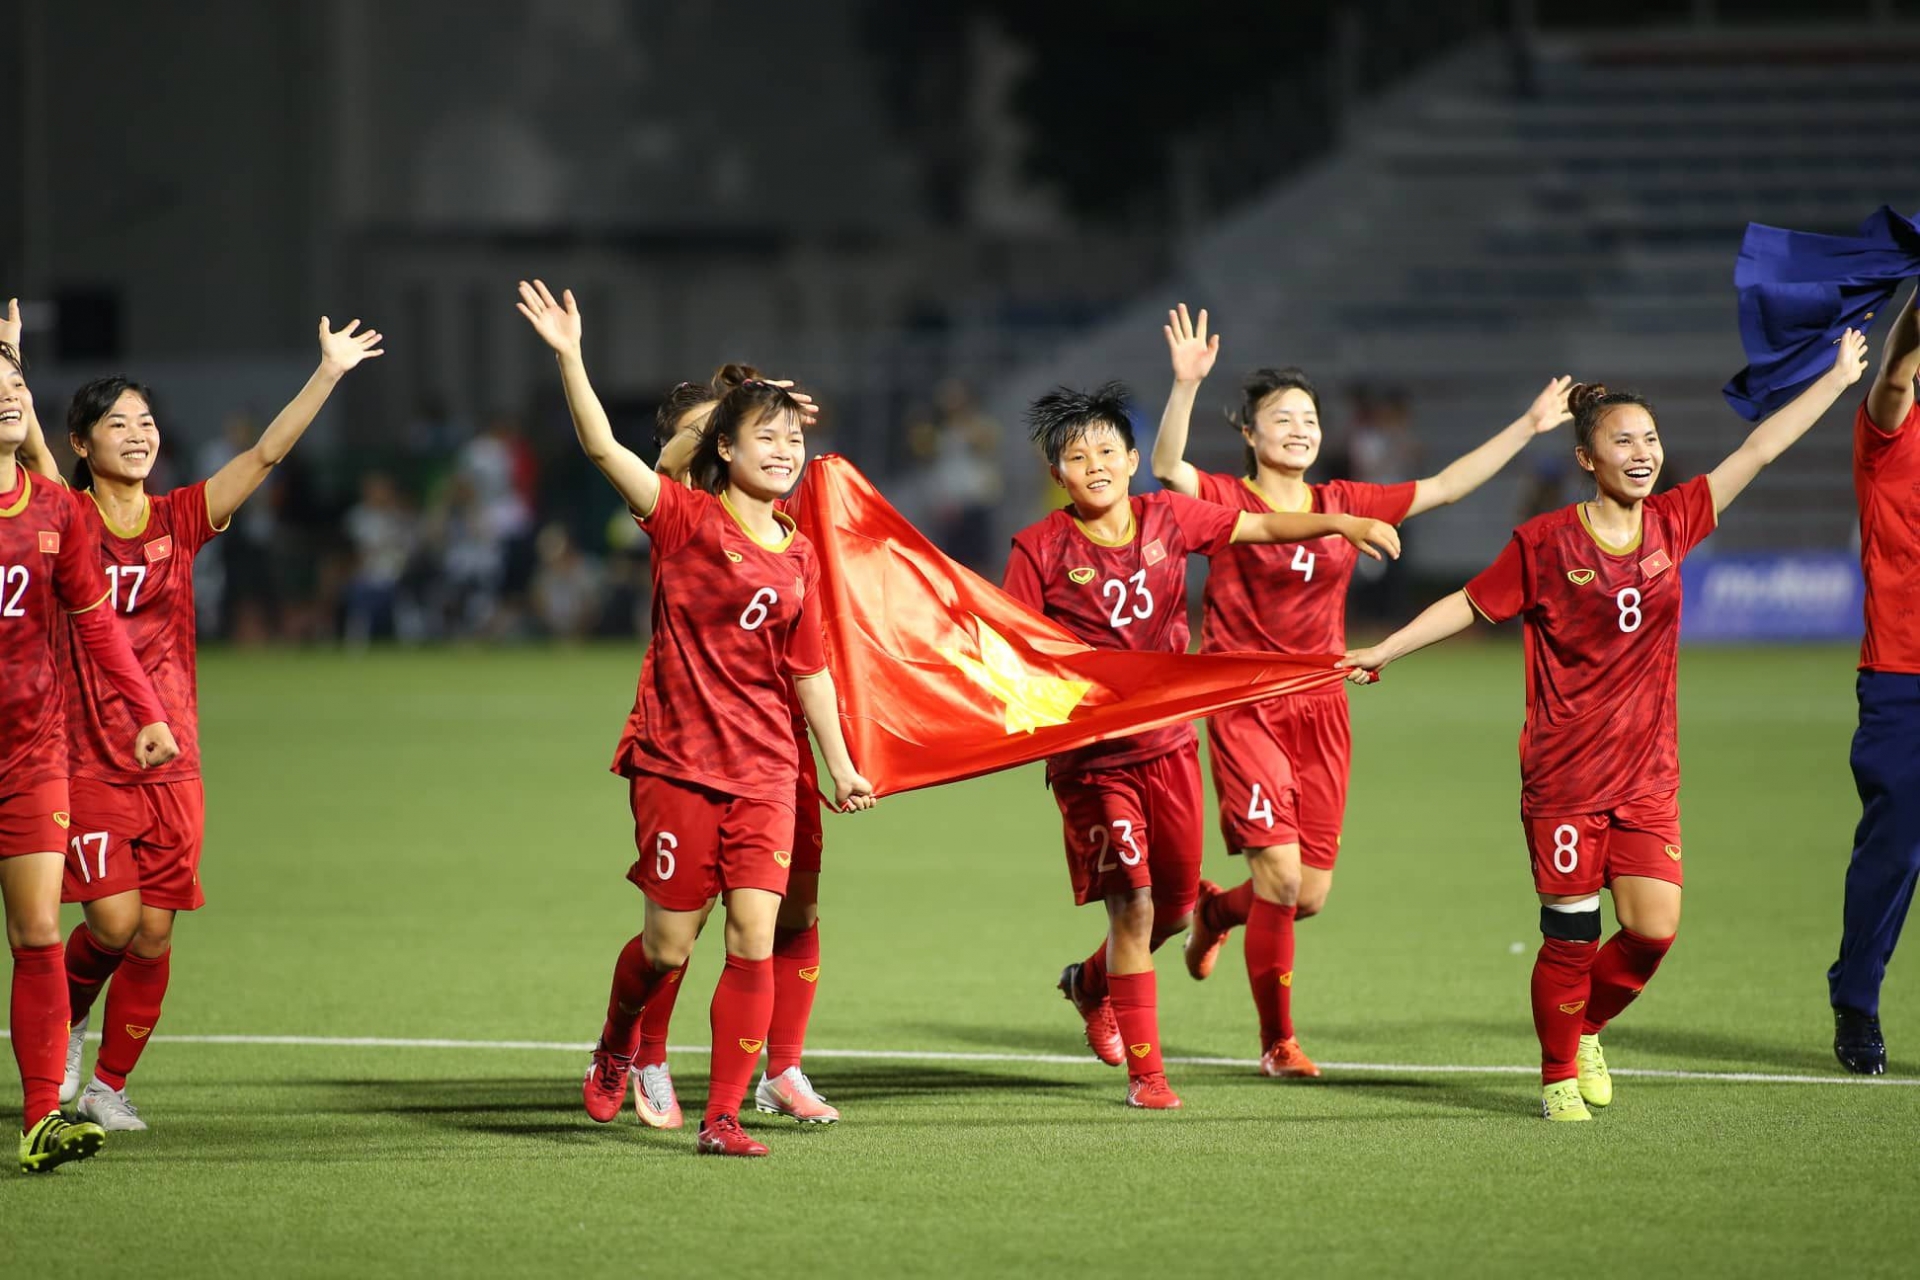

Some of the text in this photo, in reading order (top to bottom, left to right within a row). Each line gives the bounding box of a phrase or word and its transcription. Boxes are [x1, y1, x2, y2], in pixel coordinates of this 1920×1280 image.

[1291, 545, 1315, 582] 4
[105, 565, 147, 613] 17
[739, 587, 777, 631] 6
[1102, 568, 1154, 627] 23
[1616, 587, 1642, 633] 8
[1247, 783, 1274, 829] 4
[71, 832, 109, 883] 17
[656, 831, 678, 881] 6
[1088, 820, 1143, 872] 23
[1553, 824, 1578, 873] 8
